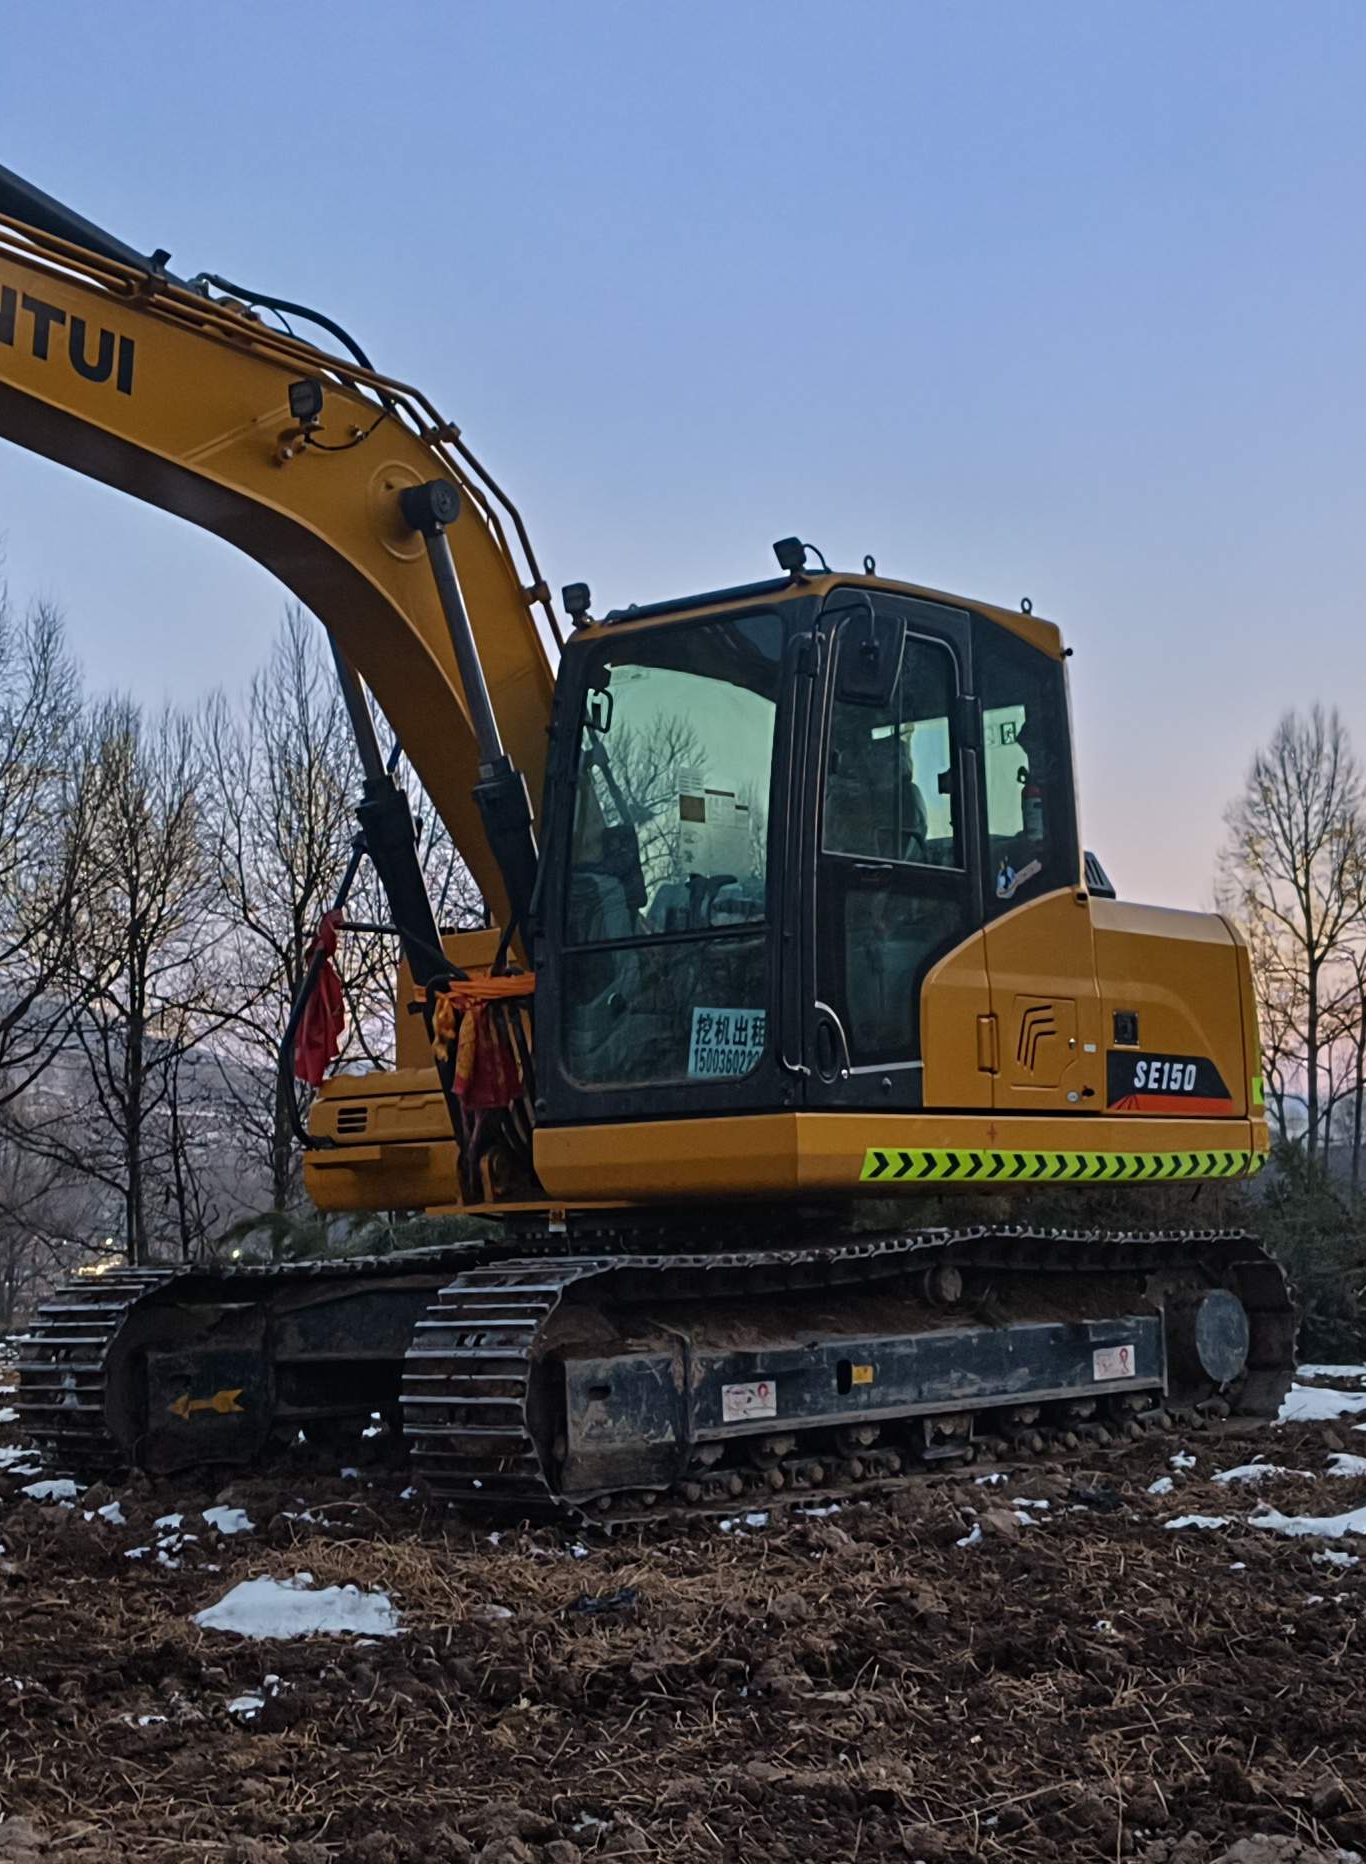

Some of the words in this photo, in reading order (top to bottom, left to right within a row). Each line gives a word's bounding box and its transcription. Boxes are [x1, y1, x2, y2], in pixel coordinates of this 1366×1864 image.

[696, 1013, 765, 1047] 挖机出租
[1134, 1060, 1197, 1091] SE150
